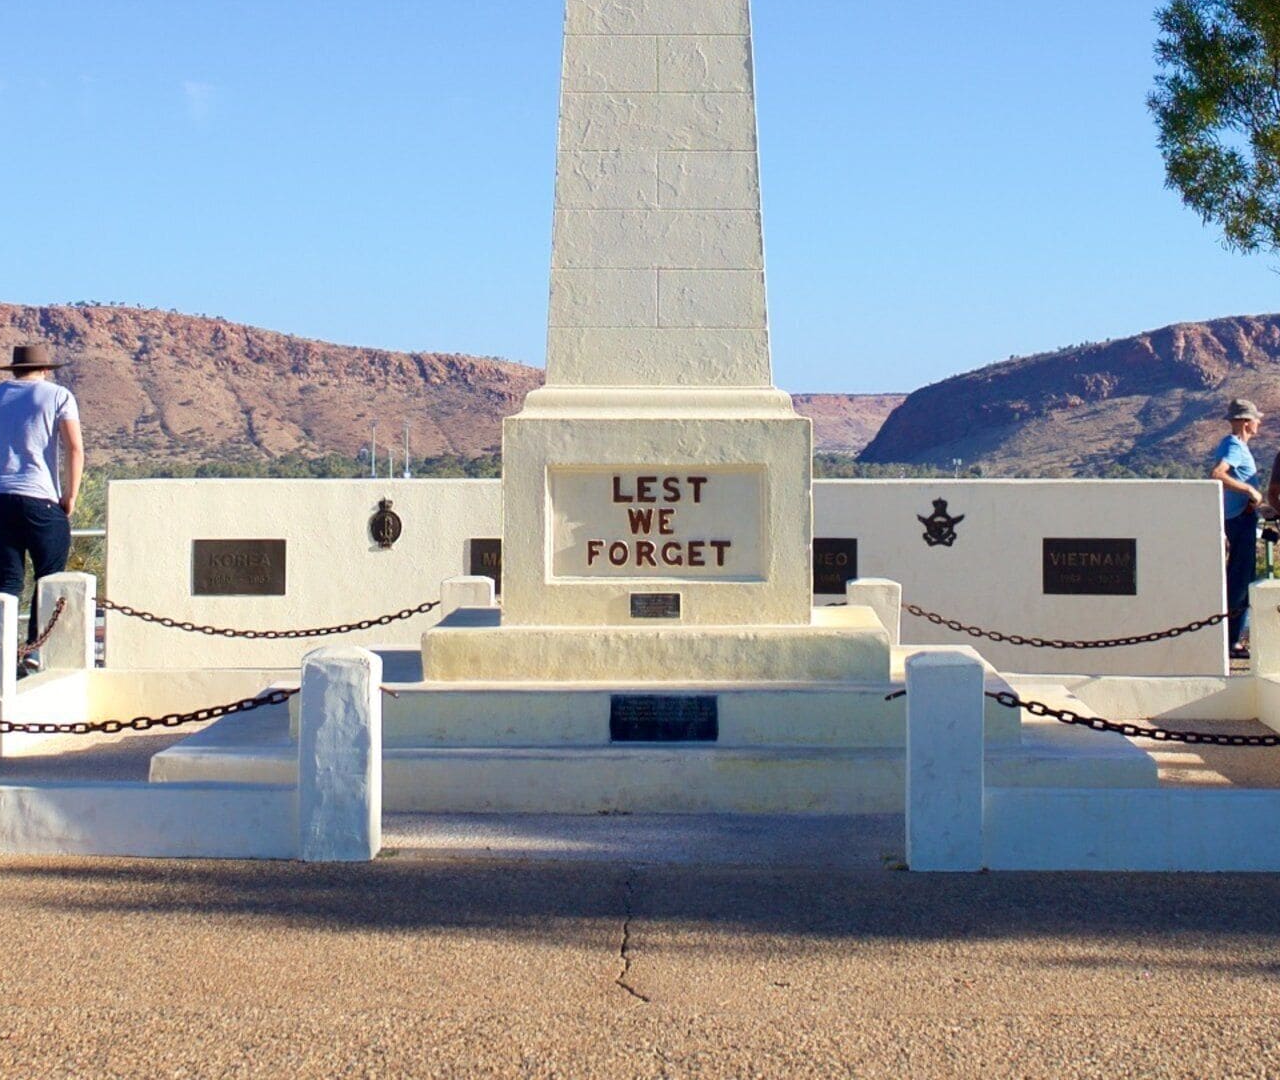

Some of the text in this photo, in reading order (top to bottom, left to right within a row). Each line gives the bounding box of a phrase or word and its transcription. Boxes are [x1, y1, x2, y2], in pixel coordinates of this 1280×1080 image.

[612, 476, 708, 503] LEST
[627, 508, 676, 535] WE
[208, 552, 272, 567] KOREA
[586, 540, 732, 567] FORGET
[1049, 552, 1131, 566] VIETNAM
